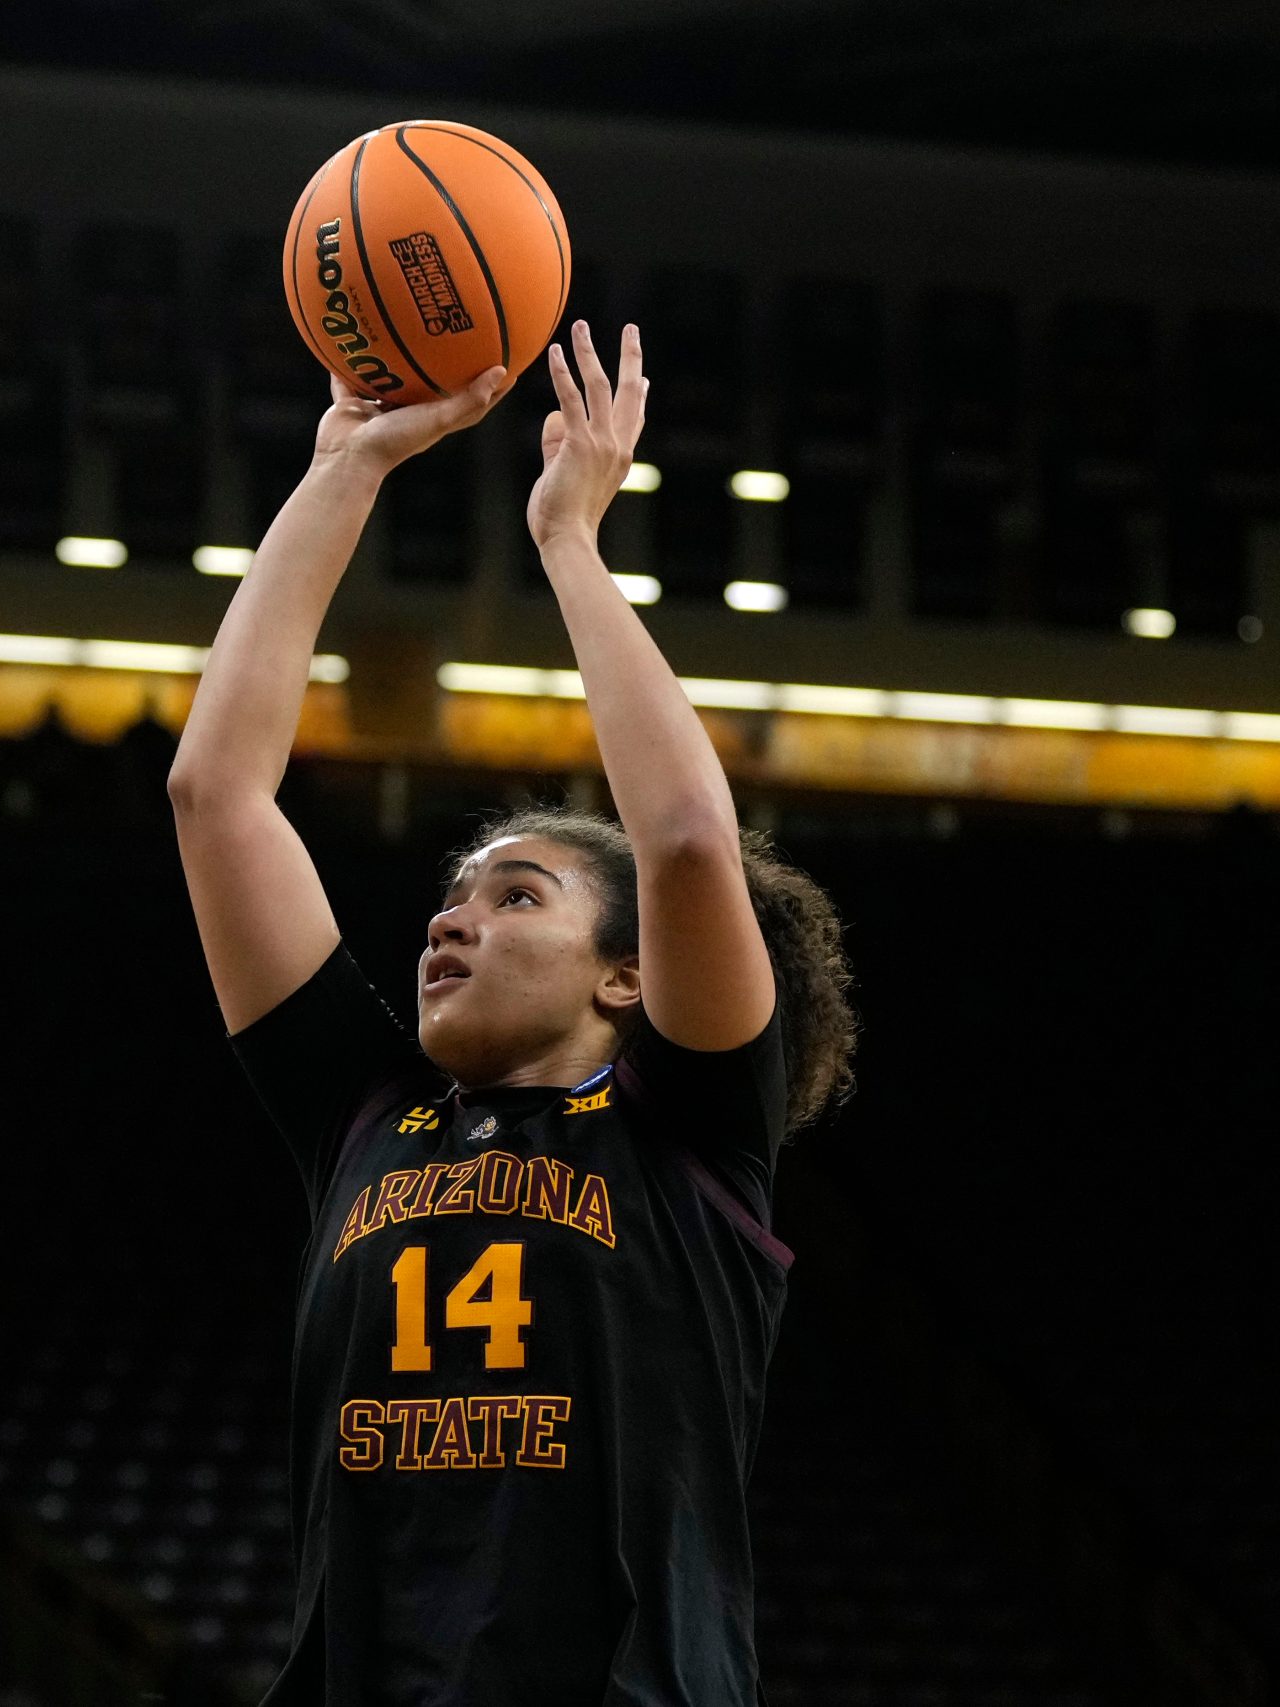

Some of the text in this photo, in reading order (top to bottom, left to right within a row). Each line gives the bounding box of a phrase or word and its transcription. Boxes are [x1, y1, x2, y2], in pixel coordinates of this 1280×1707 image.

[316, 217, 405, 394] Wilson
[406, 265, 439, 319] MARCH
[411, 232, 456, 309] MADNESS
[563, 1084, 611, 1115] XII
[333, 1150, 616, 1264] ARIZONA
[391, 1241, 533, 1373] 14
[339, 1396, 572, 1471] STATE
